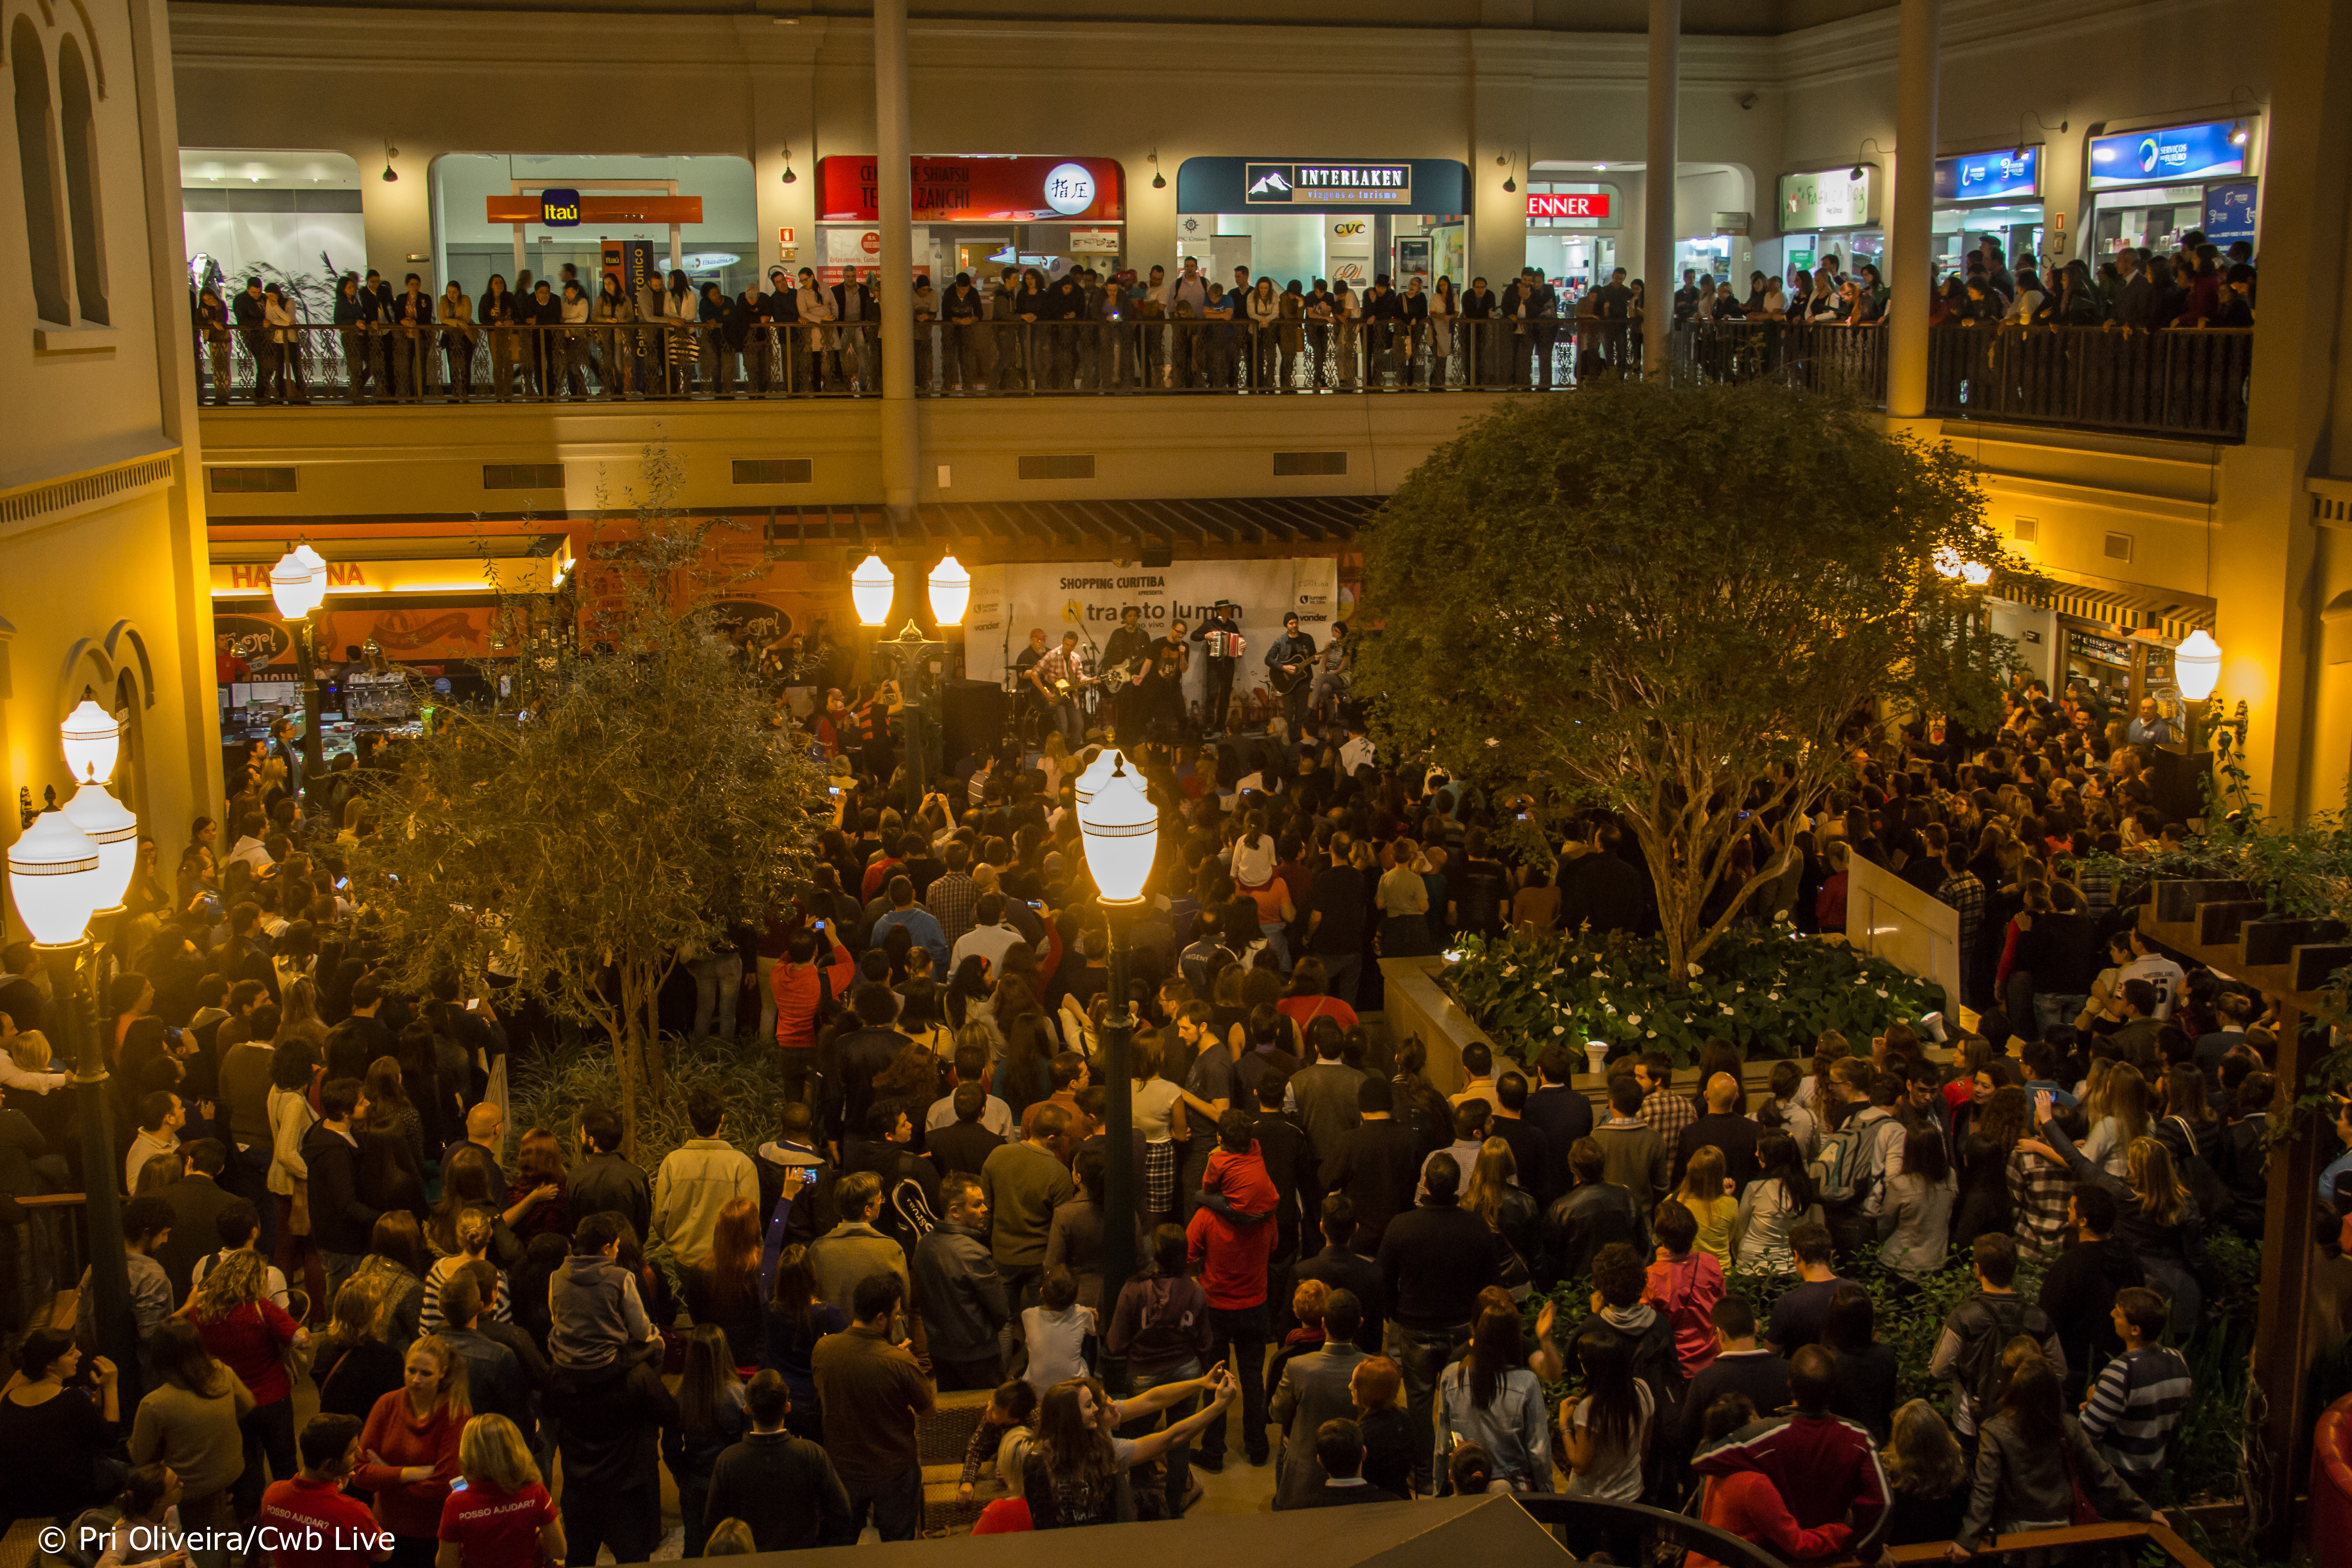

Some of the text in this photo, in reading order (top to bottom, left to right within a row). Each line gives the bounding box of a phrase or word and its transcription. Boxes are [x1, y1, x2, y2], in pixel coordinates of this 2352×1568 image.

[2160, 143, 2187, 154] SERVIÇOS
[2165, 153, 2187, 162] FUTURO
[923, 167, 969, 182] SHIATSU
[1301, 168, 1402, 186] INTERLAKEN
[918, 187, 969, 209] ZANCHI
[1308, 190, 1345, 200] viagens
[1359, 190, 1397, 199] turismo
[544, 204, 578, 220] Itaú
[1526, 198, 1589, 215] ENNER
[1334, 223, 1366, 234] CVC
[633, 249, 643, 315] trônico
[230, 563, 365, 588] HANA
[1060, 576, 1165, 590] SHOPPING CURITIBA
[1086, 600, 1243, 620] trato lumn
[974, 621, 1000, 631] vonder
[1185, 954, 1208, 963] ARGENT
[2152, 978, 2167, 1004] 5
[267, 1505, 329, 1529] POSSO AJUDAR?
[459, 1499, 535, 1520] POSSO AJUDAR?
